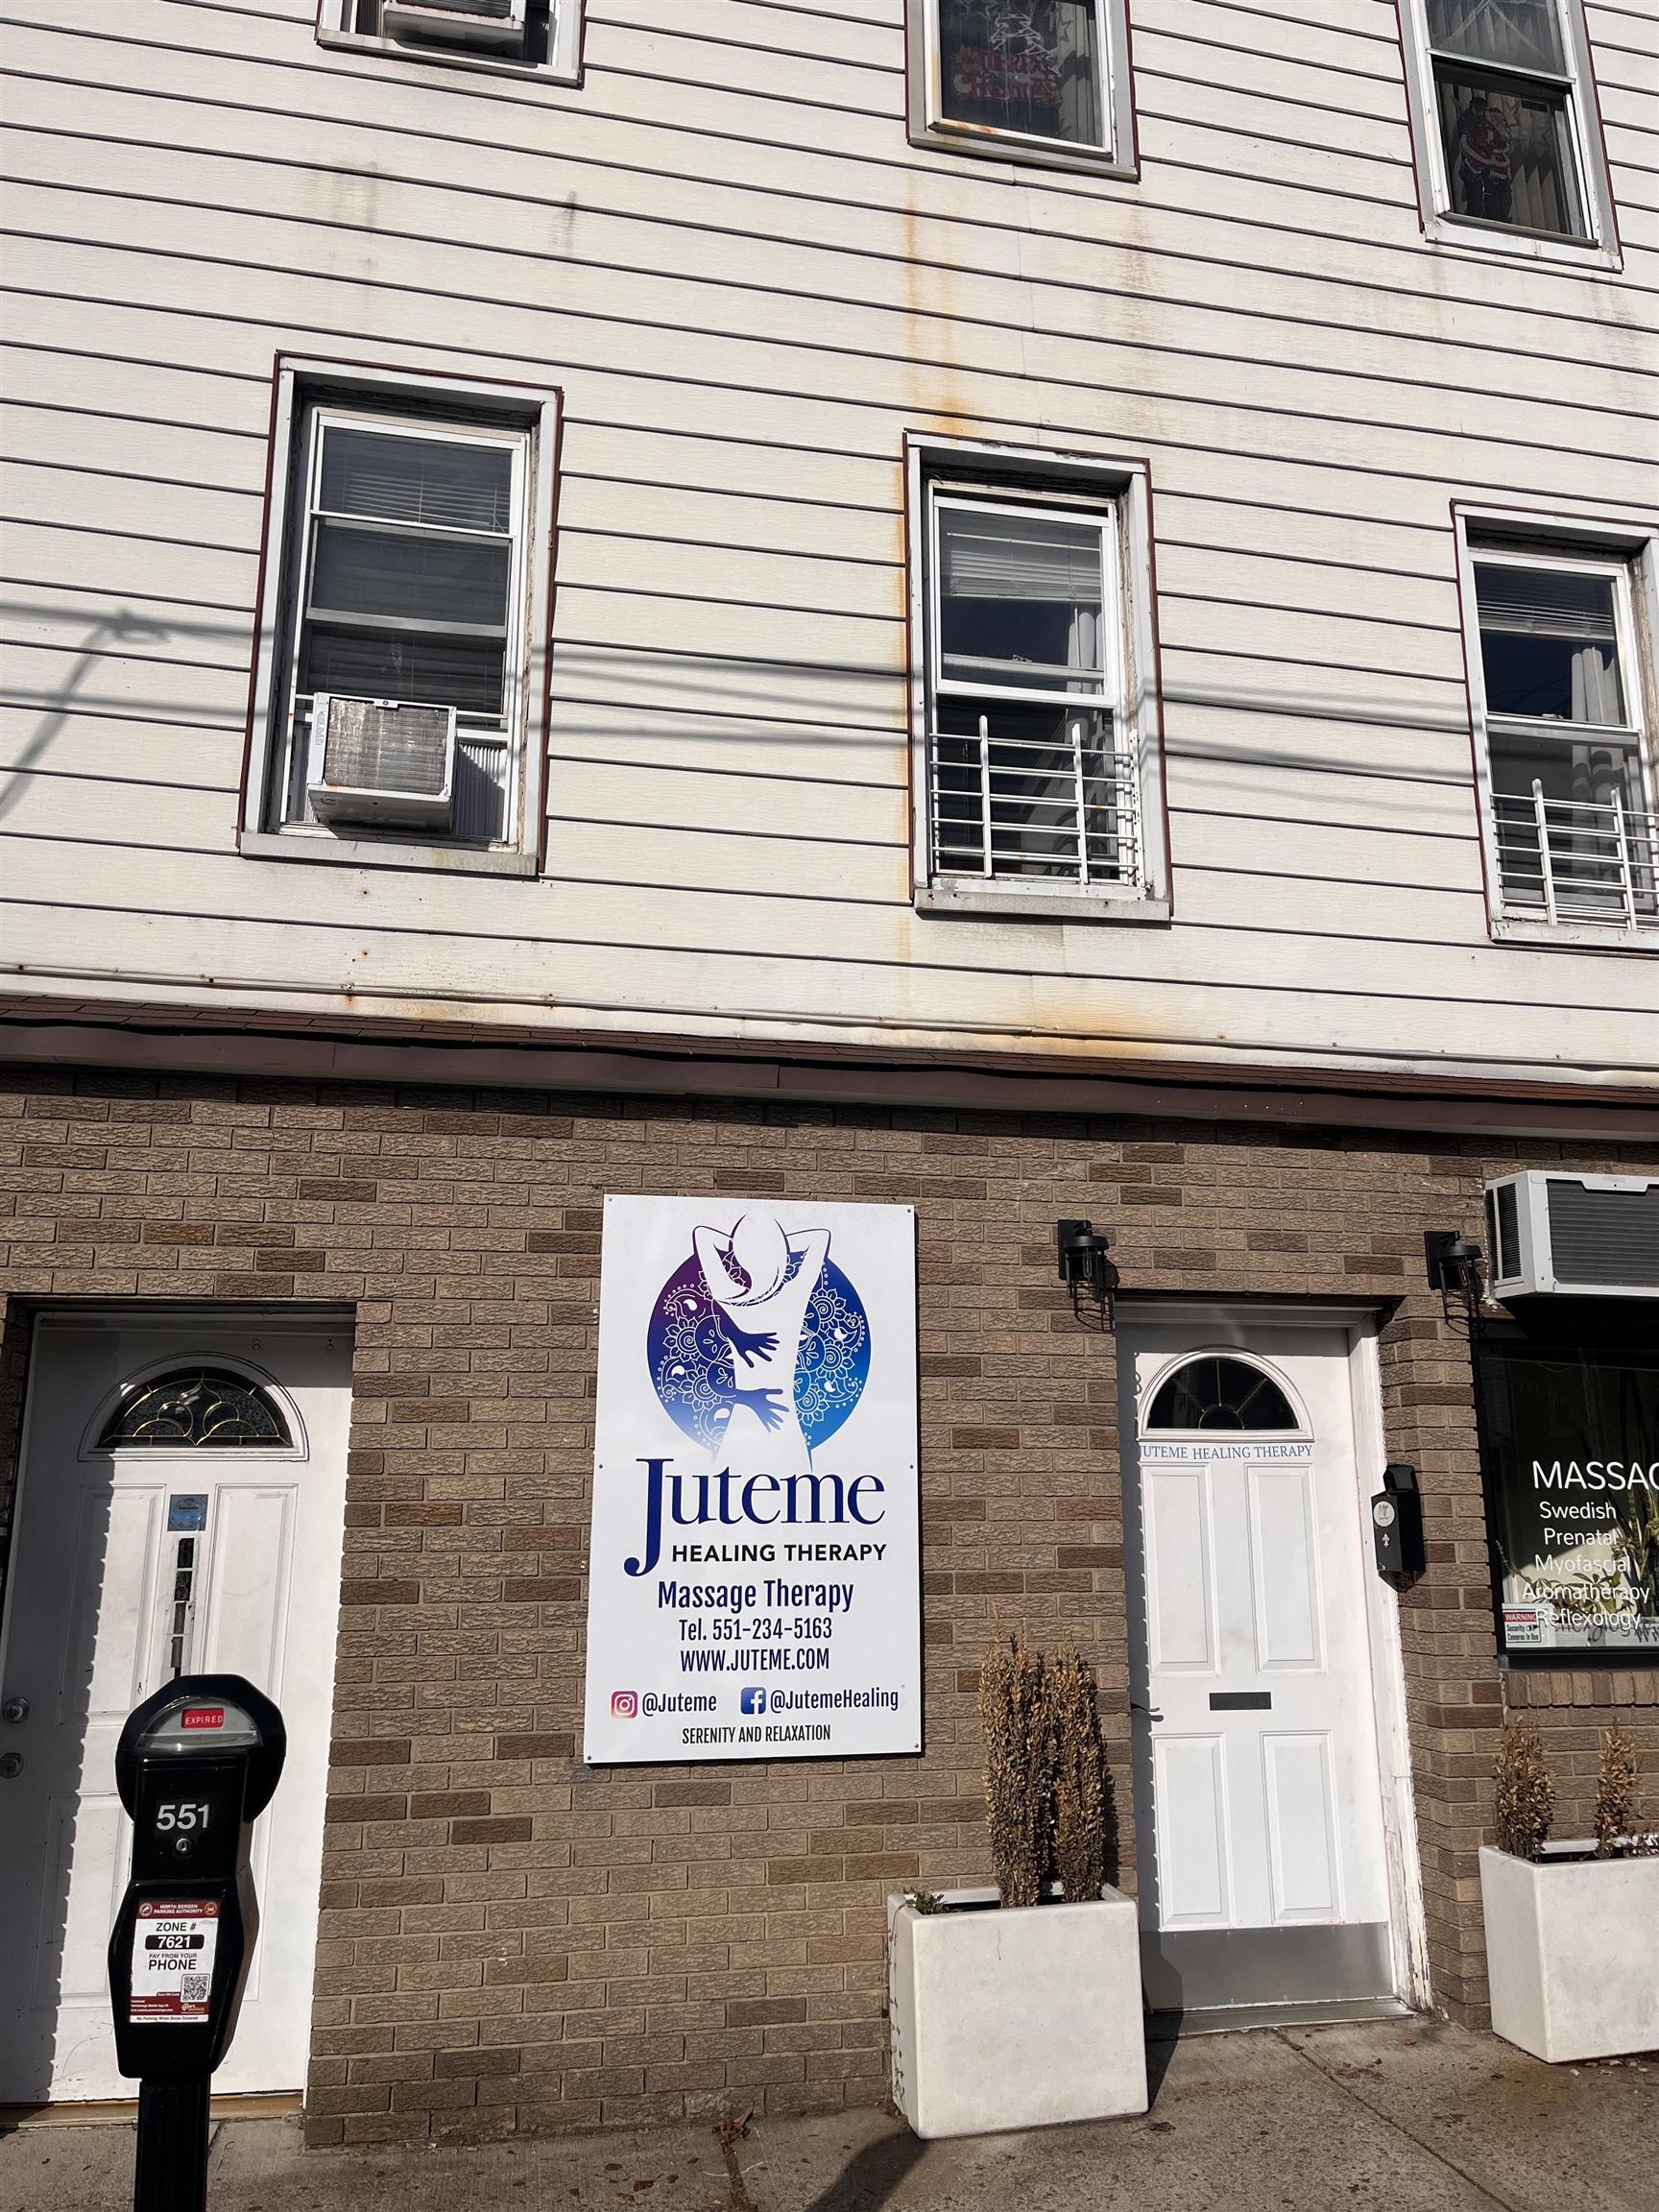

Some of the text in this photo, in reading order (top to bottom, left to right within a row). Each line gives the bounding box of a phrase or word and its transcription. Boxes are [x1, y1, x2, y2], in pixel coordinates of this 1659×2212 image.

[1192, 1447, 1251, 1460] HEALING
[1254, 1445, 1313, 1458] THERAPY
[623, 1457, 886, 1577] Juteme
[1539, 1501, 1617, 1519] Swedish
[1544, 1527, 1617, 1546] Prenatal
[672, 1543, 887, 1562] HEALING THERAPY
[1535, 1553, 1631, 1575] Myofascial
[658, 1578, 854, 1614] Massage Therapy
[1522, 1583, 1650, 1605] Aromatherapy
[1506, 1624, 1526, 1633] Security
[1536, 1608, 1642, 1629] Reflexology
[679, 1617, 832, 1642] Tel. 551-234-5163
[680, 1647, 830, 1672] WWW.JUTEME.COM
[641, 1693, 717, 1716] @Juteme
[769, 1688, 900, 1713] @JutemeHealing
[185, 1716, 223, 1724] EXPIRED
[682, 1724, 831, 1744] SERENITY AND RELAXATION
[156, 1804, 211, 1830] 551
[156, 1922, 197, 1932] ZONE #
[157, 1936, 191, 1949] 7621
[148, 1960, 197, 1971] PHONE
